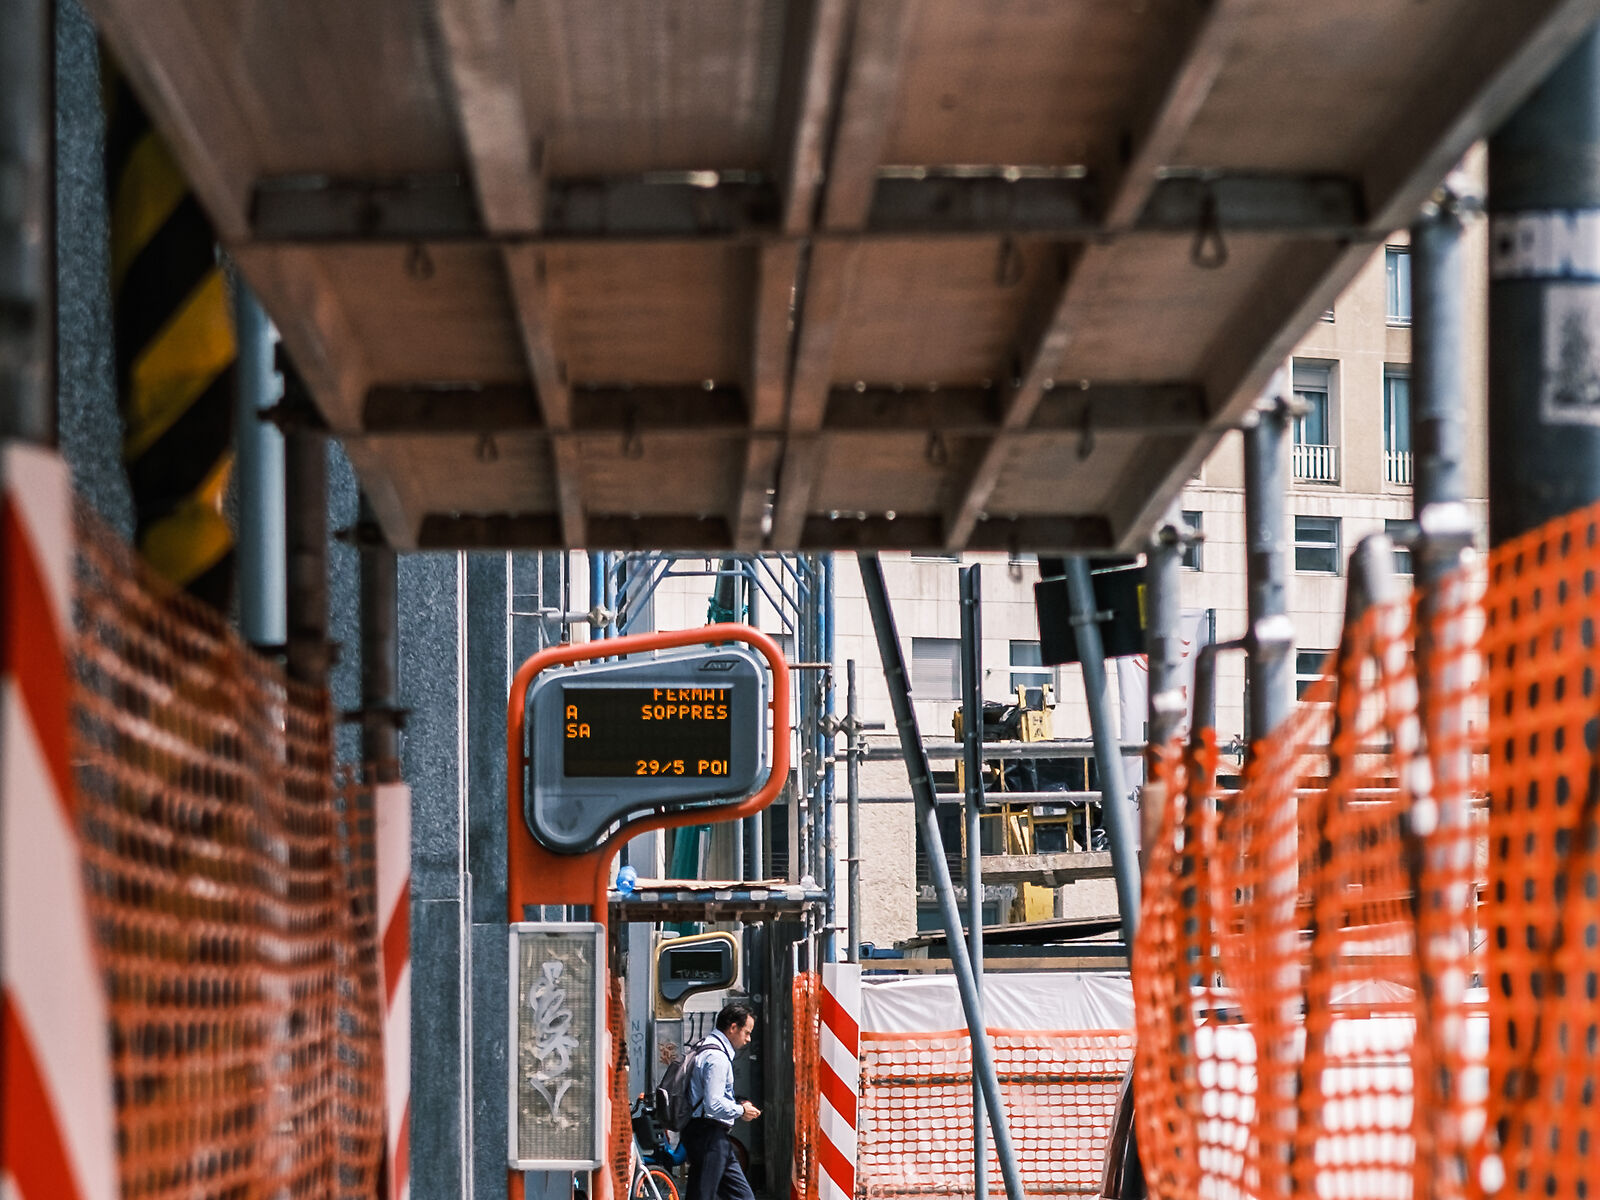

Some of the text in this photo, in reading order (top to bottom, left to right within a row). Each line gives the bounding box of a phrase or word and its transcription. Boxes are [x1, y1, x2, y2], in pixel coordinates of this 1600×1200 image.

[566, 704, 728, 720] A SOPPRES
[566, 723, 591, 738] SA
[635, 759, 728, 775] 29/5 POI
